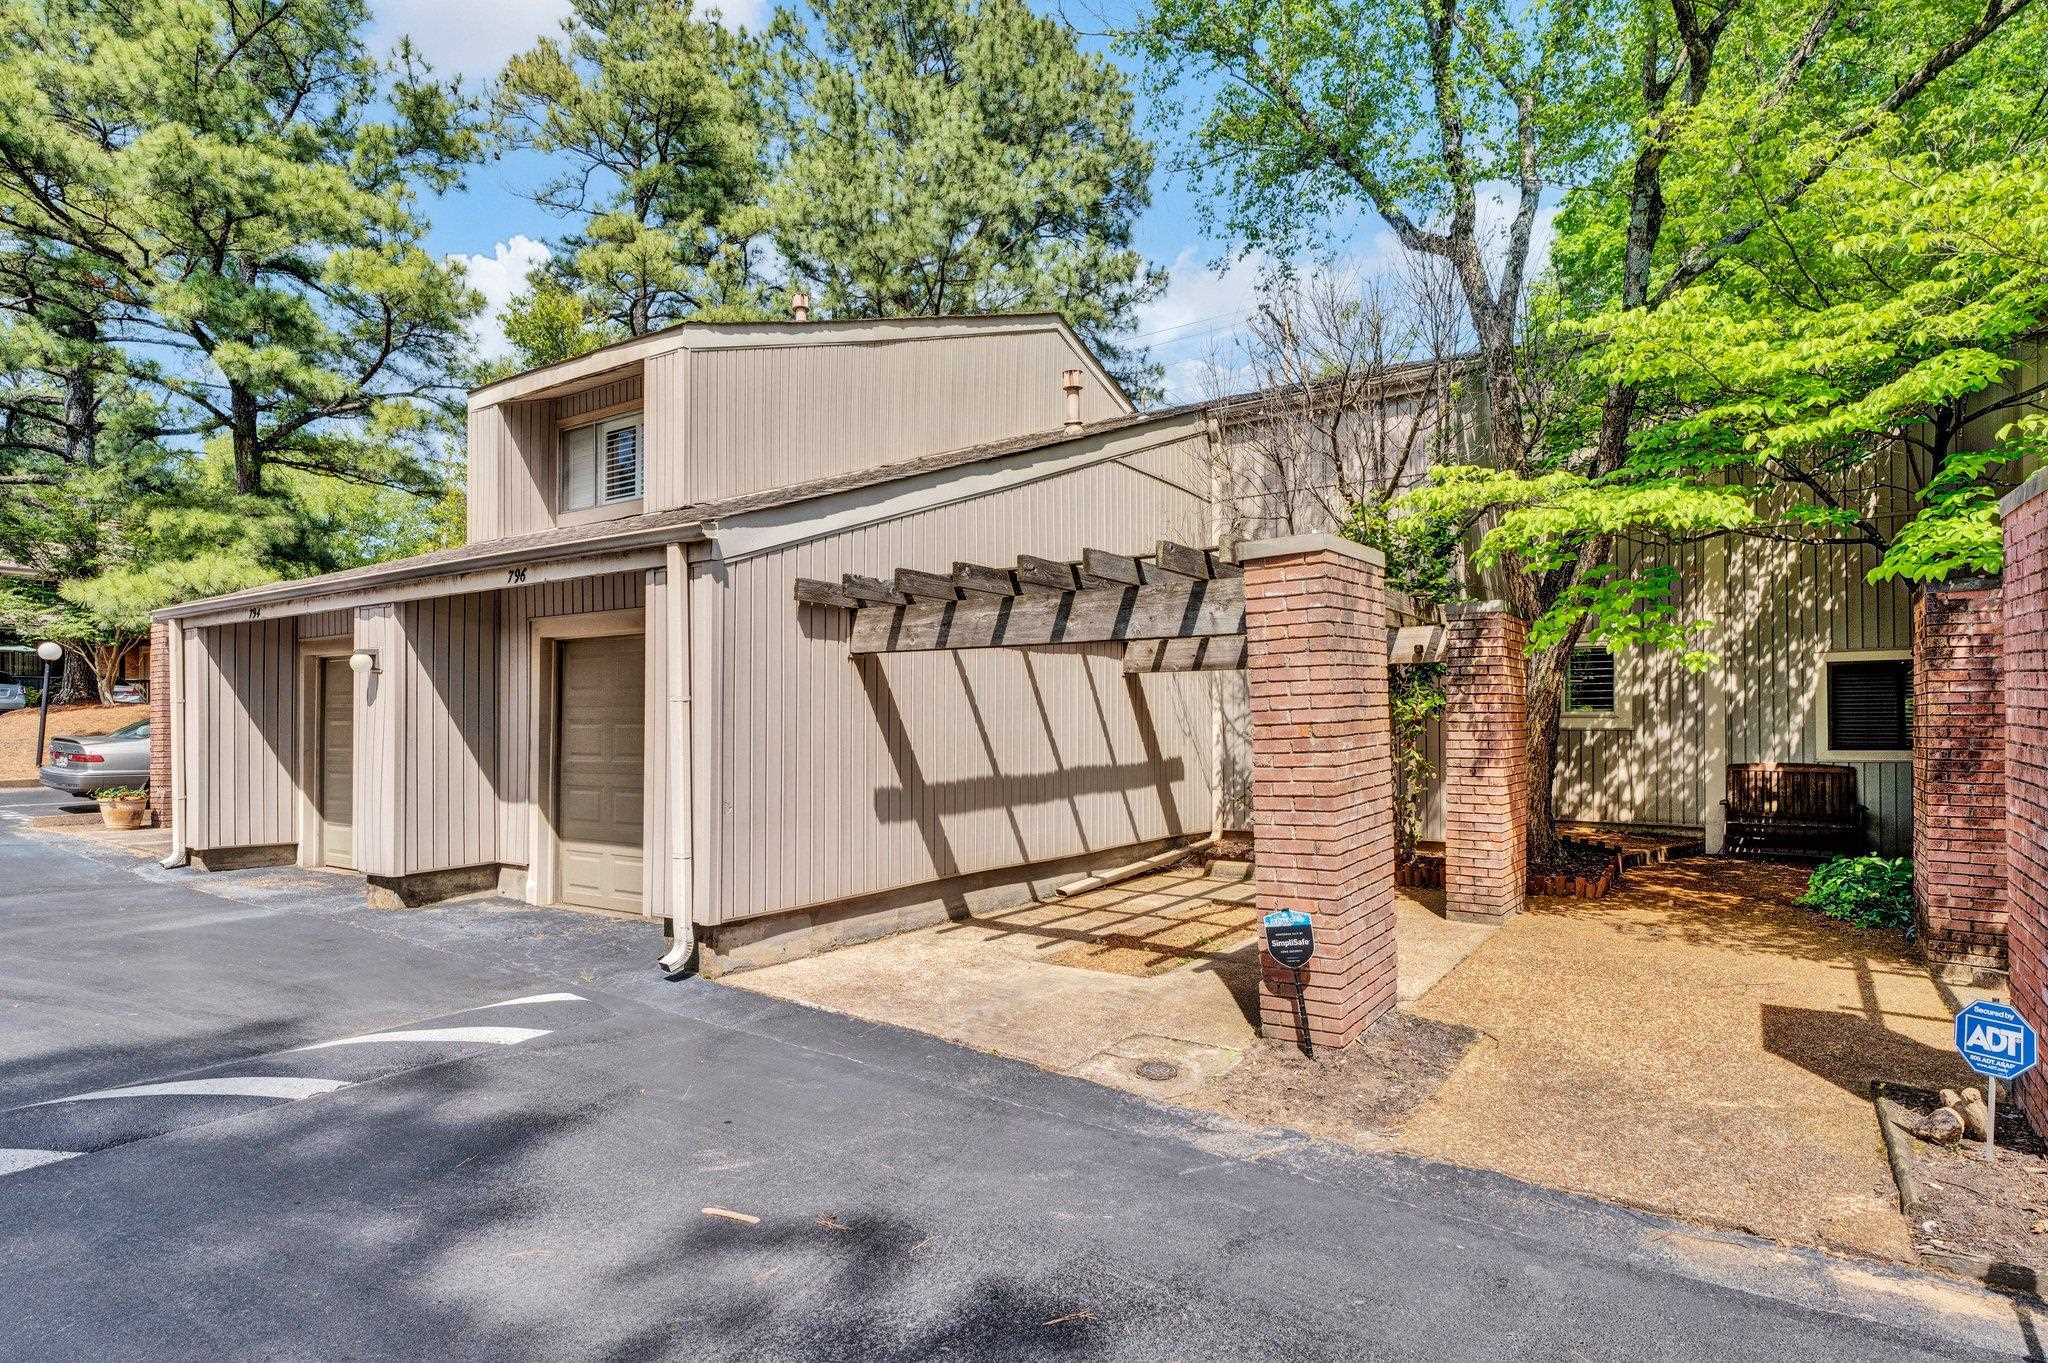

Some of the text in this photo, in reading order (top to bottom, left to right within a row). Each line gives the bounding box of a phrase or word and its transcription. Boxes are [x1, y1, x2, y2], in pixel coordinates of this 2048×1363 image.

[507, 567, 527, 583] 796
[1271, 938, 1310, 947] SimpliSafe
[1973, 1005, 2014, 1021] Secured by
[1966, 1023, 2023, 1056] ADT
